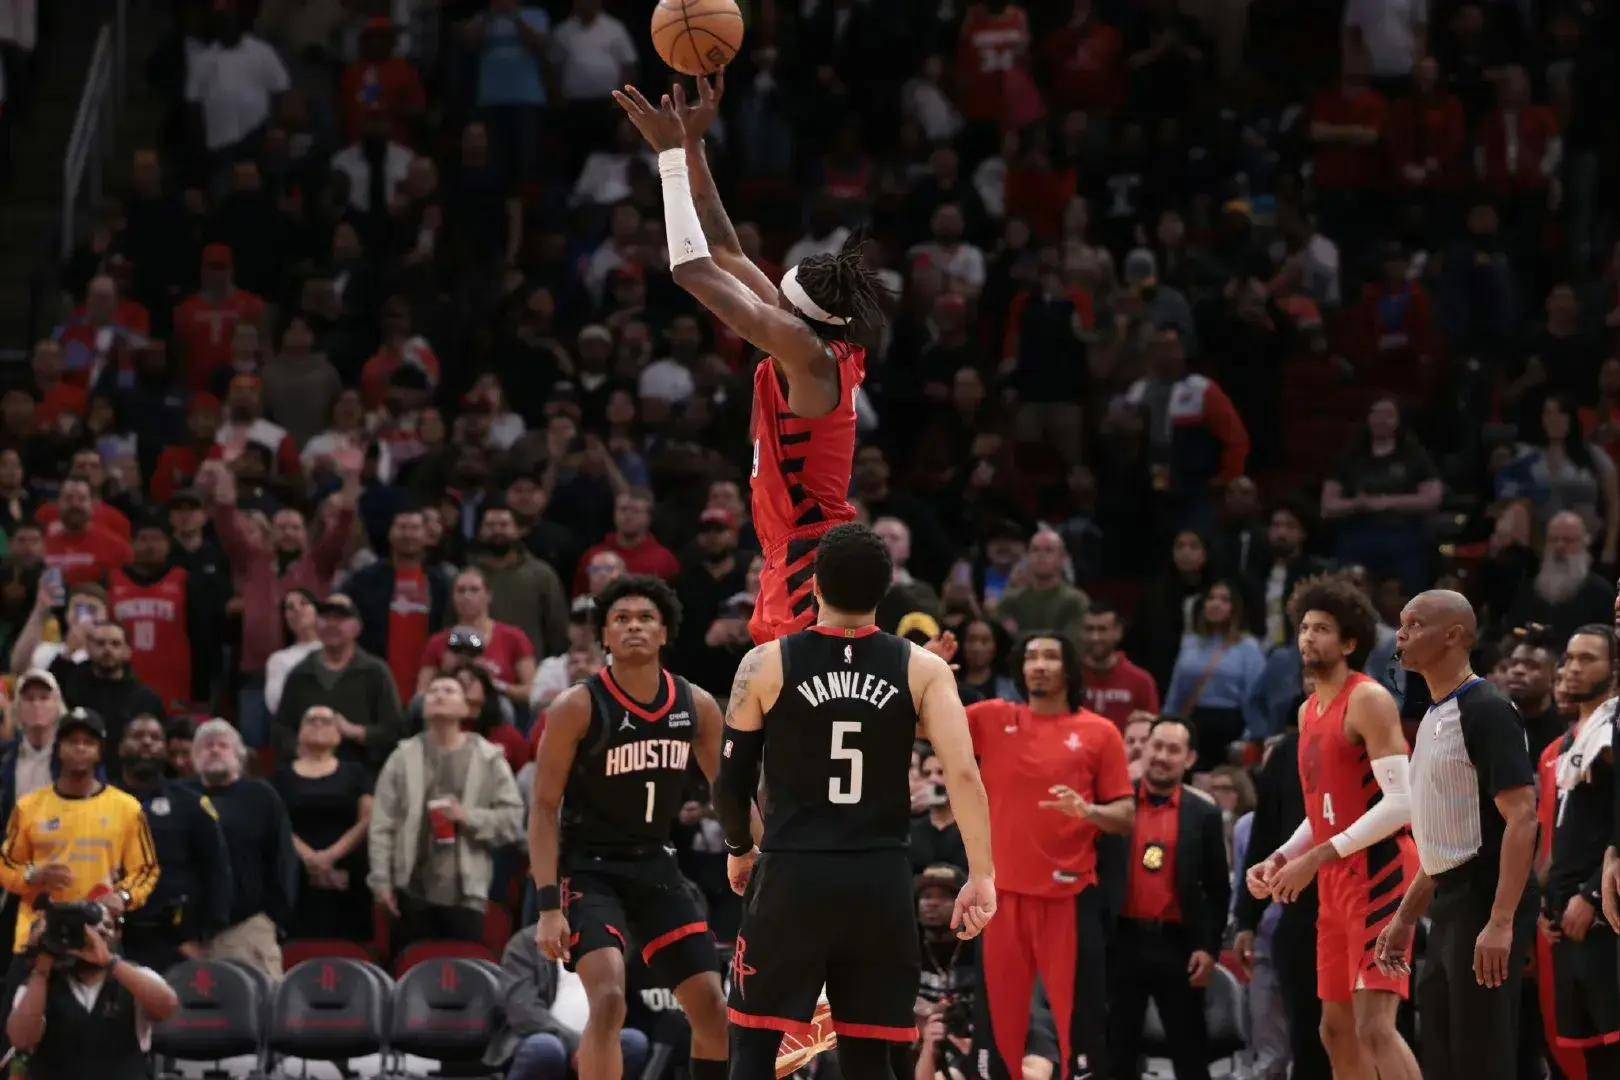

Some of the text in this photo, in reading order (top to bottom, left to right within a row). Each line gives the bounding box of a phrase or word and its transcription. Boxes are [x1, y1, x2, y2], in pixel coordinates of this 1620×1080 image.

[797, 671, 899, 709] VANVLEET
[668, 711, 689, 720] credit
[668, 719, 691, 728] karma
[605, 739, 691, 776] HOUSTON
[829, 721, 863, 804] 5
[645, 781, 655, 823] 1
[1323, 793, 1335, 826] 4
